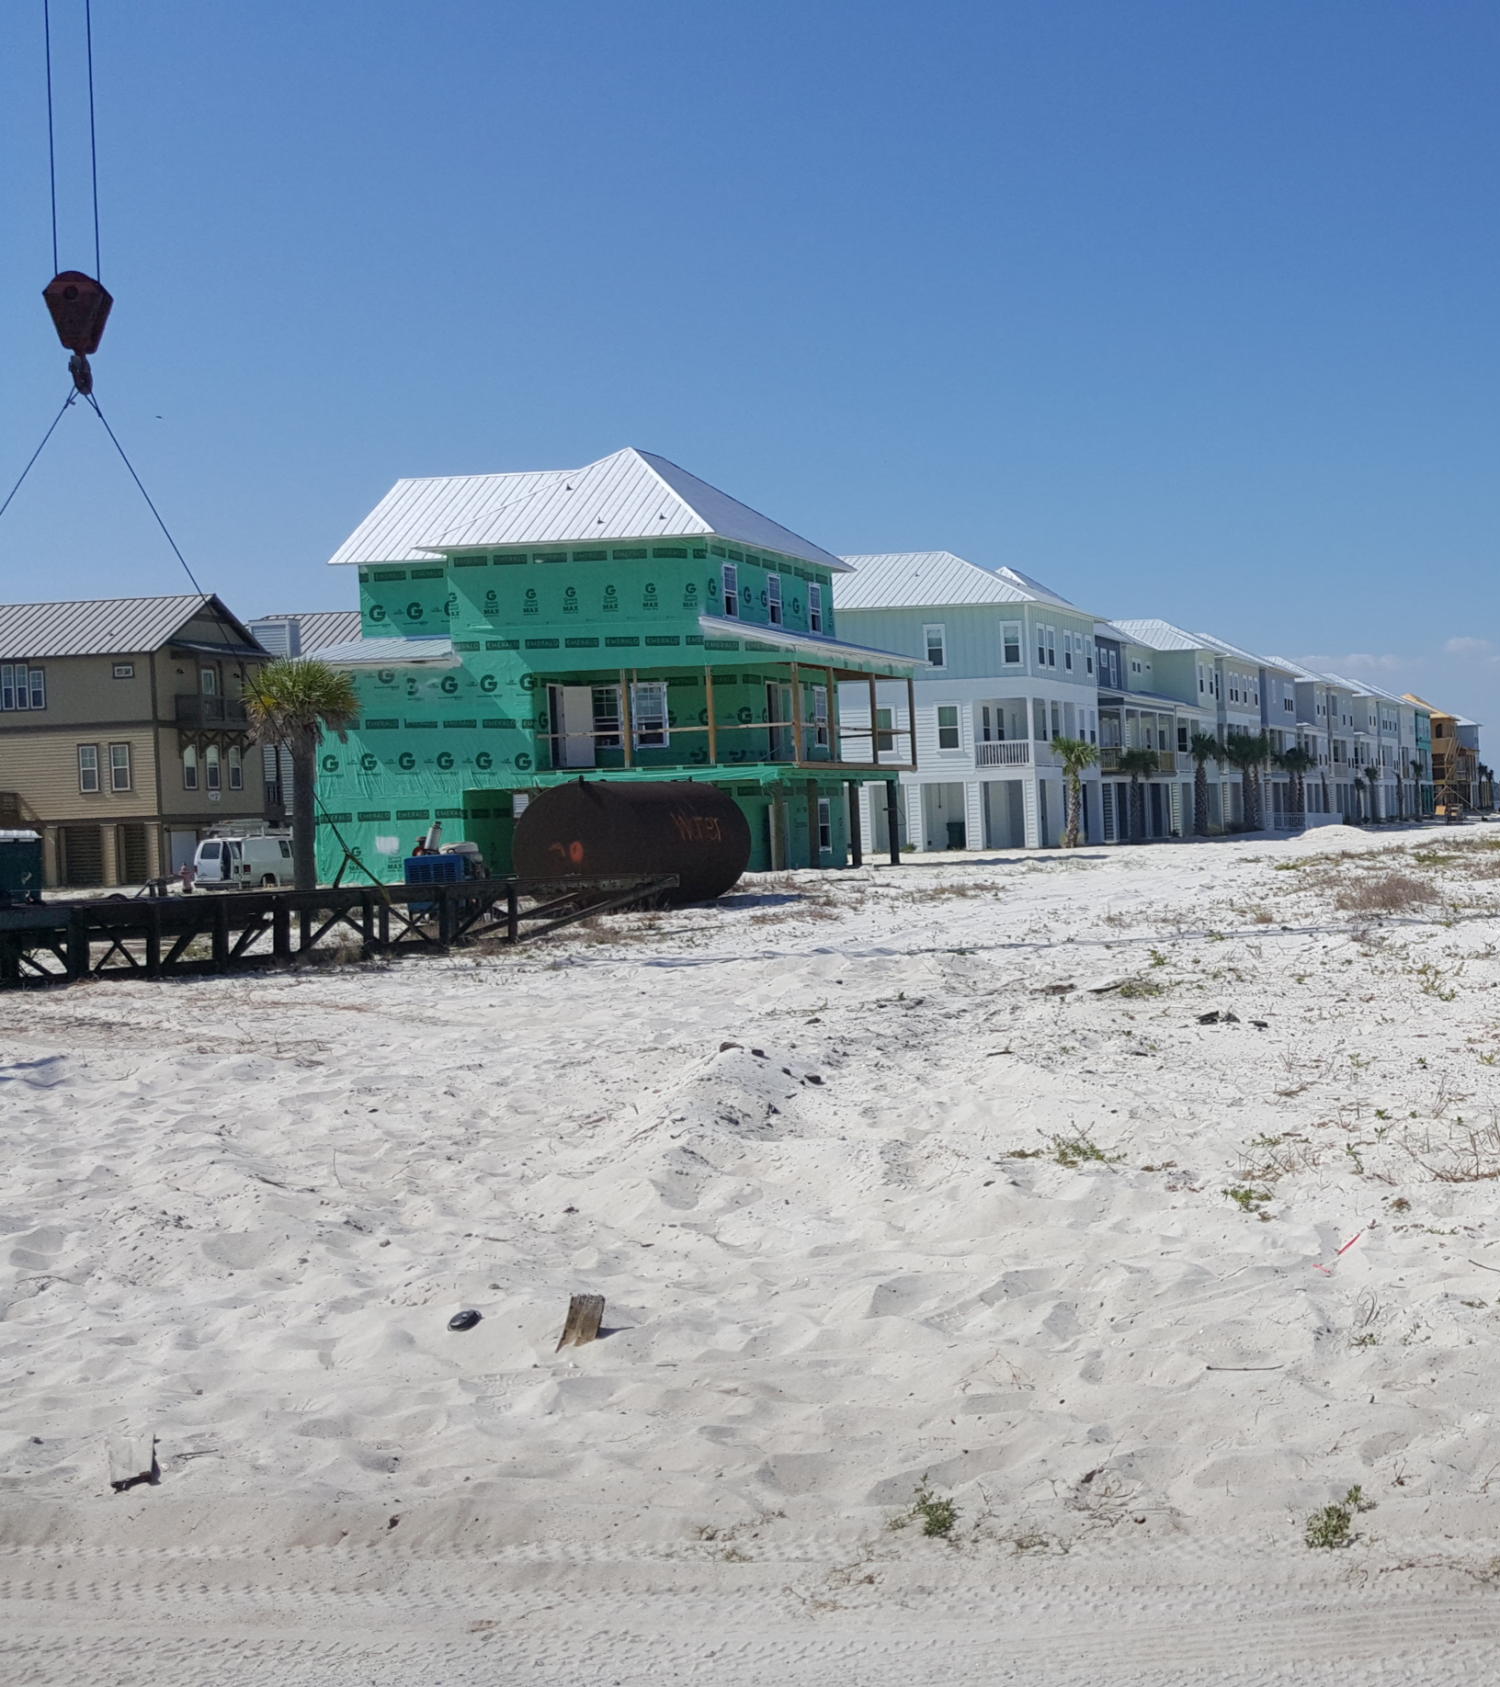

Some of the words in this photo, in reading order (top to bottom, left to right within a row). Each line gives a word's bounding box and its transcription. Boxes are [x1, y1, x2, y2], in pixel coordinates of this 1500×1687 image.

[369, 605, 386, 622] G
[406, 602, 424, 620] G
[441, 676, 458, 694] G
[480, 674, 497, 692] G
[520, 673, 537, 691] G
[322, 754, 339, 772] G
[361, 753, 377, 771] G
[399, 752, 415, 770] G
[437, 752, 454, 770] G
[476, 752, 492, 770] G
[515, 753, 532, 770] G
